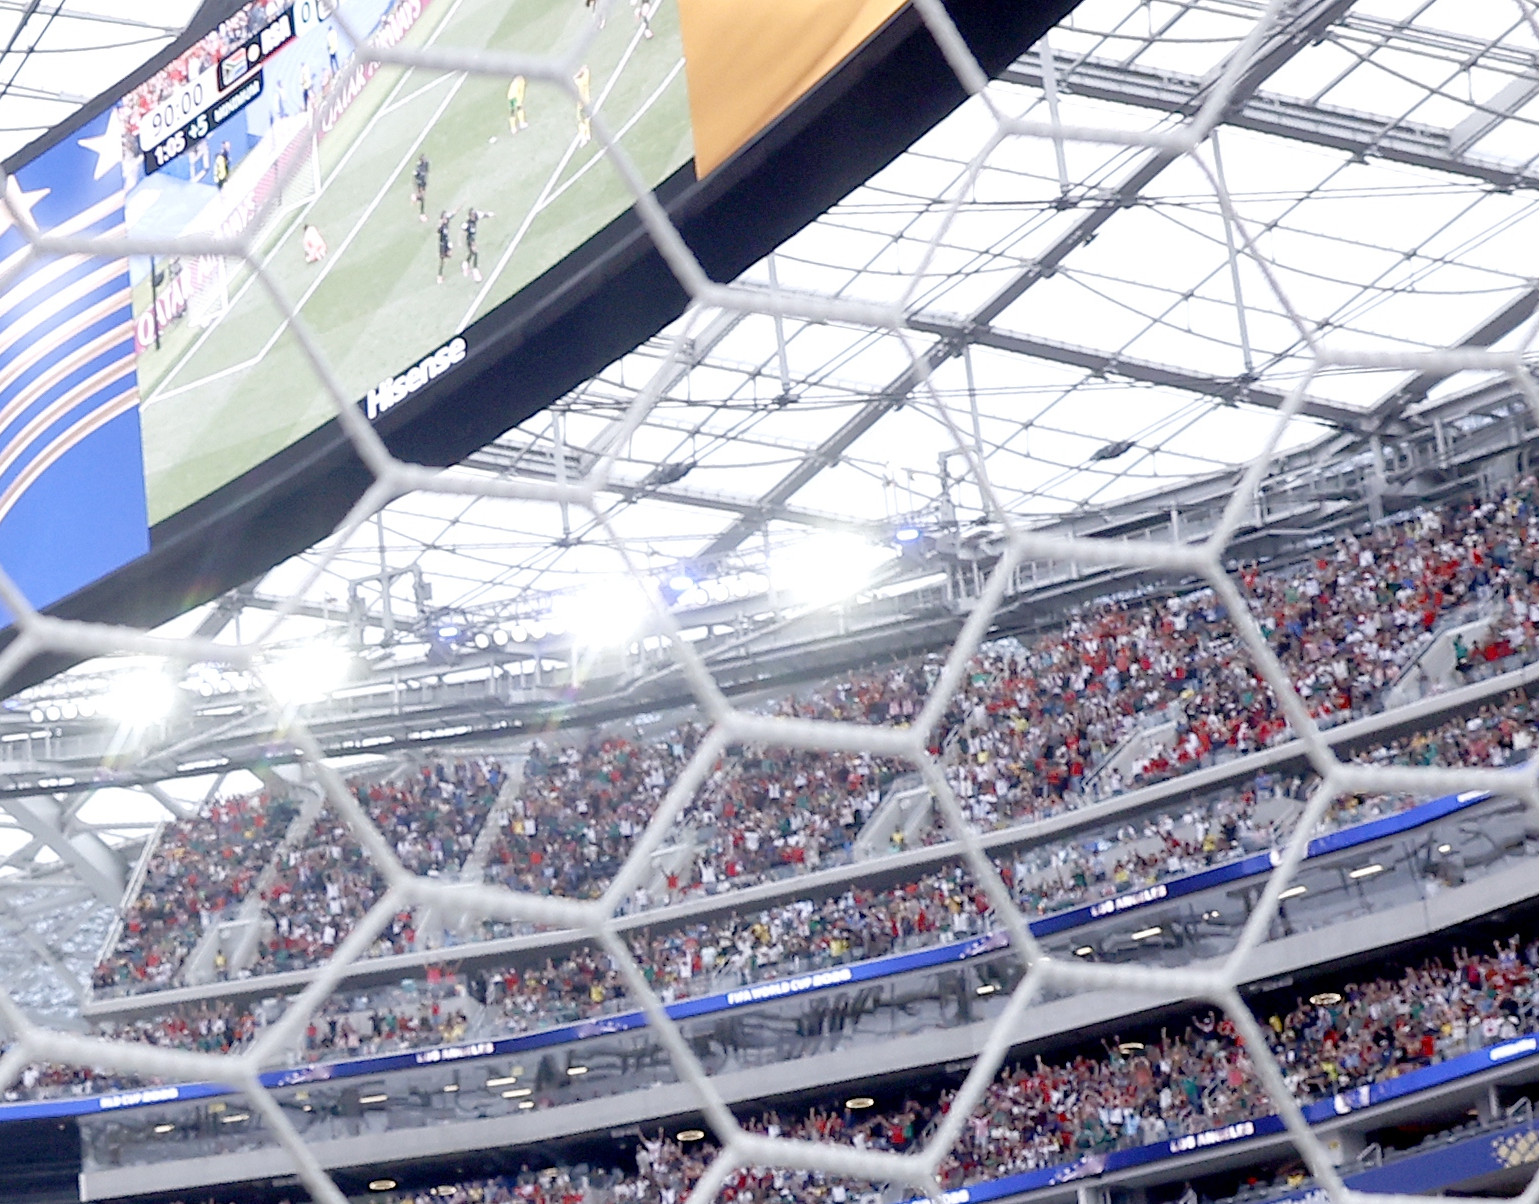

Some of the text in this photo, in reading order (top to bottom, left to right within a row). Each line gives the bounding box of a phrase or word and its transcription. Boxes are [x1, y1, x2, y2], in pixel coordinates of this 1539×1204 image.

[153, 83, 203, 137] 90:00
[155, 131, 186, 166] 1:05
[188, 114, 210, 140] +5
[367, 337, 467, 420] Hisense
